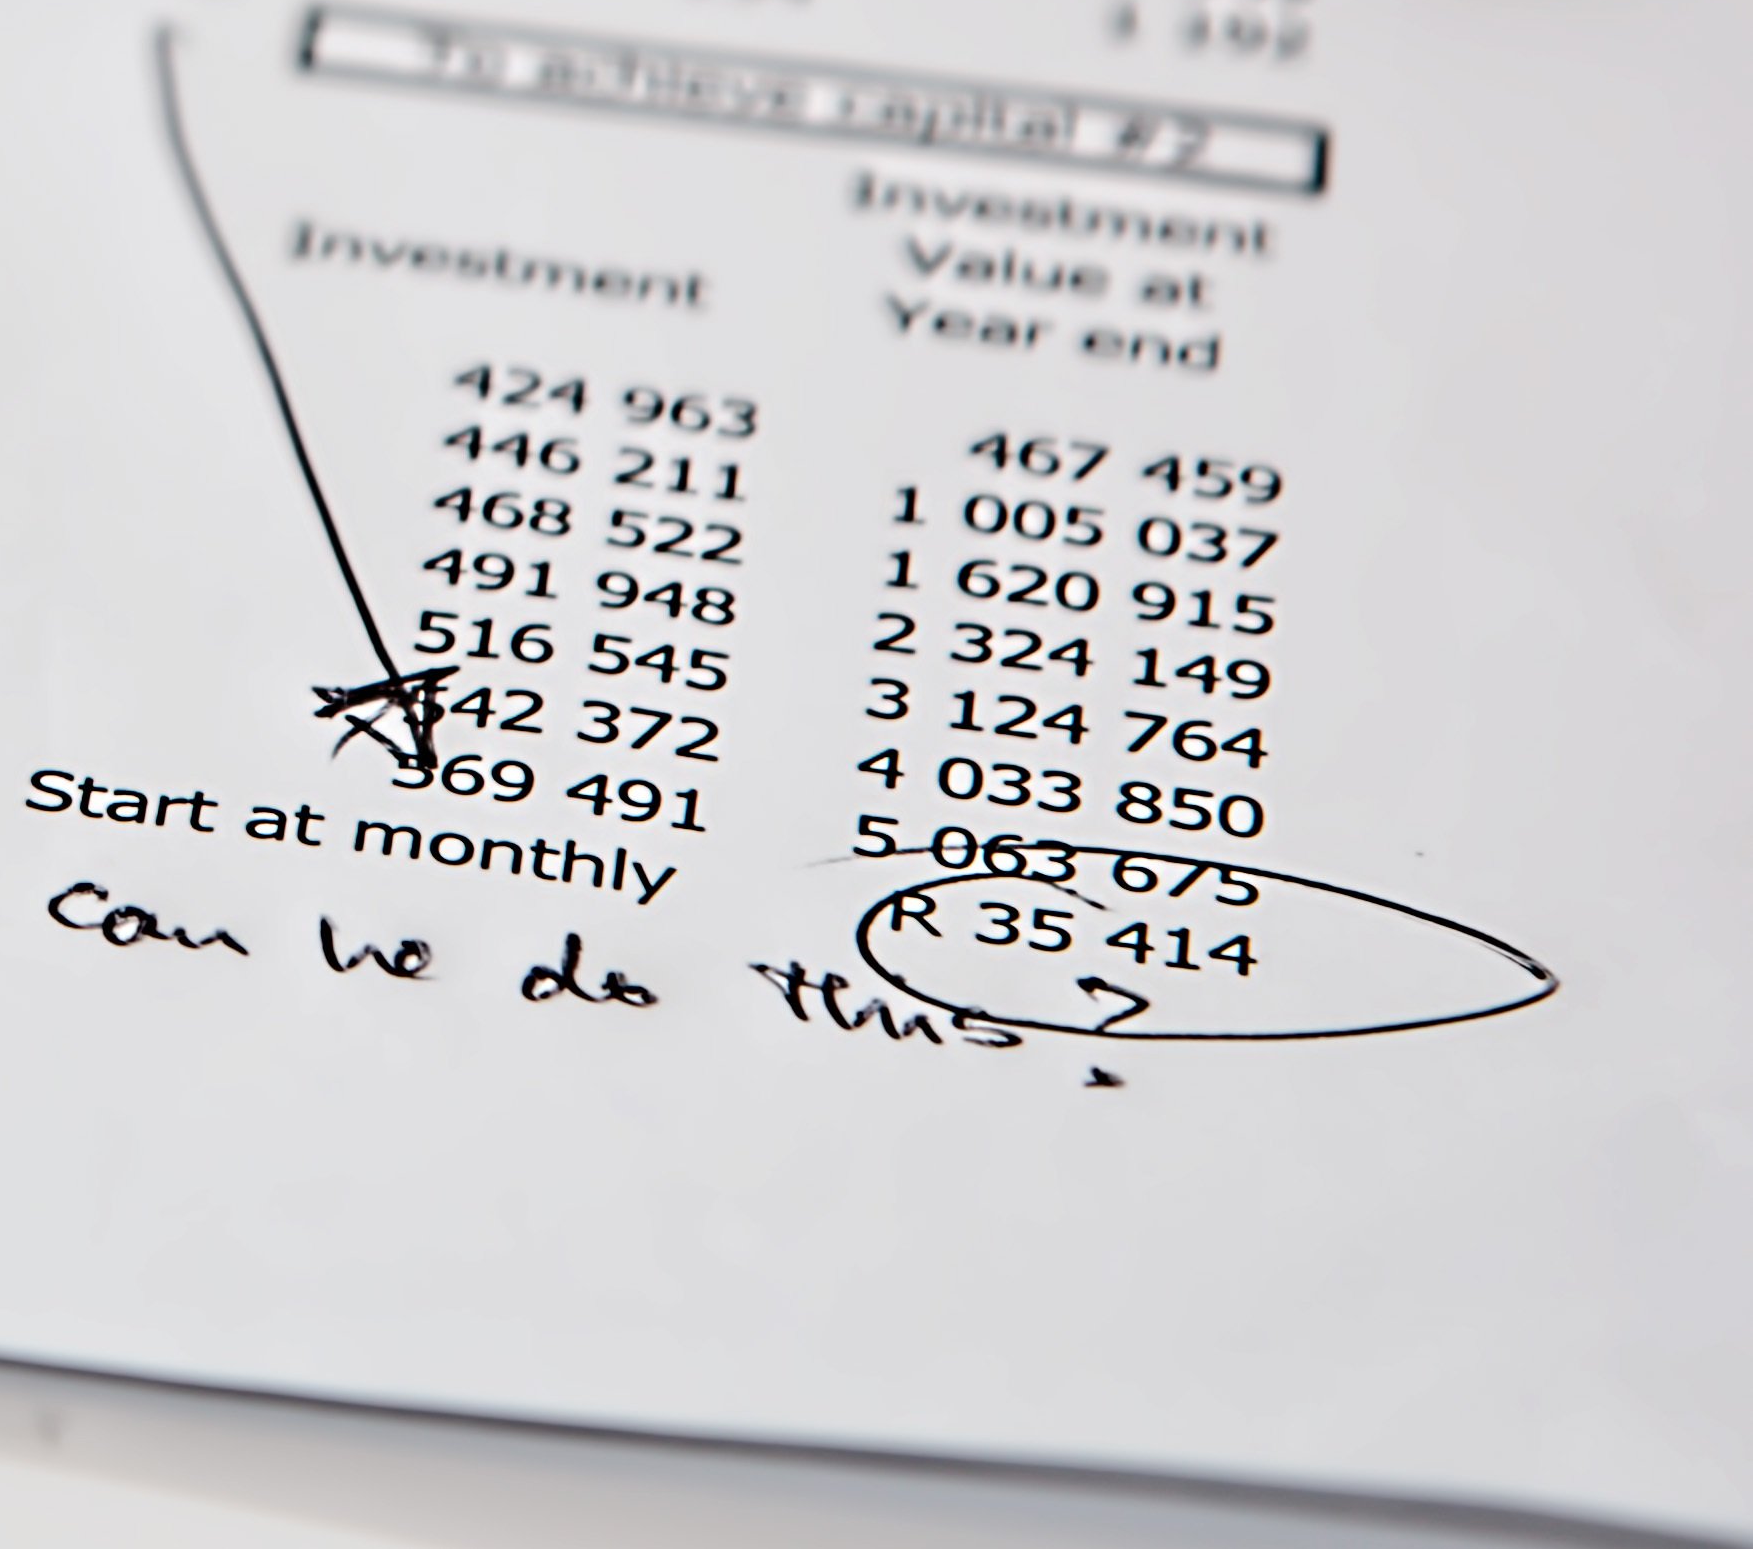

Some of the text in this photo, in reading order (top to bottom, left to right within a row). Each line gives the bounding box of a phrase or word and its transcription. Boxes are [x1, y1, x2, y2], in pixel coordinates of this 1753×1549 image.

[536, 55, 803, 117] achieve
[836, 77, 1076, 148] capital
[852, 169, 1278, 258] Investment
[296, 221, 712, 312] Investment
[903, 238, 1216, 312] Value at
[889, 289, 1221, 375] Year end
[453, 363, 760, 440] 424 963
[442, 424, 747, 501] 446 211
[967, 431, 1283, 506] 467 459
[433, 485, 742, 564] 468 522
[894, 485, 1278, 570] 1 005 037
[422, 548, 736, 626] 491 948
[887, 551, 1277, 637] 1 620 915
[414, 610, 728, 692] 516 545
[874, 613, 1272, 701] 2 324 149
[577, 699, 721, 762] 372
[865, 679, 1269, 770] 3 124 764
[391, 754, 708, 834] 569 491
[858, 749, 1266, 839] 4 033 850
[26, 768, 677, 906] Start at monthly
[853, 815, 1260, 907] 5 063 675
[521, 934, 658, 1007] do
[892, 893, 1258, 978] R 35 414
